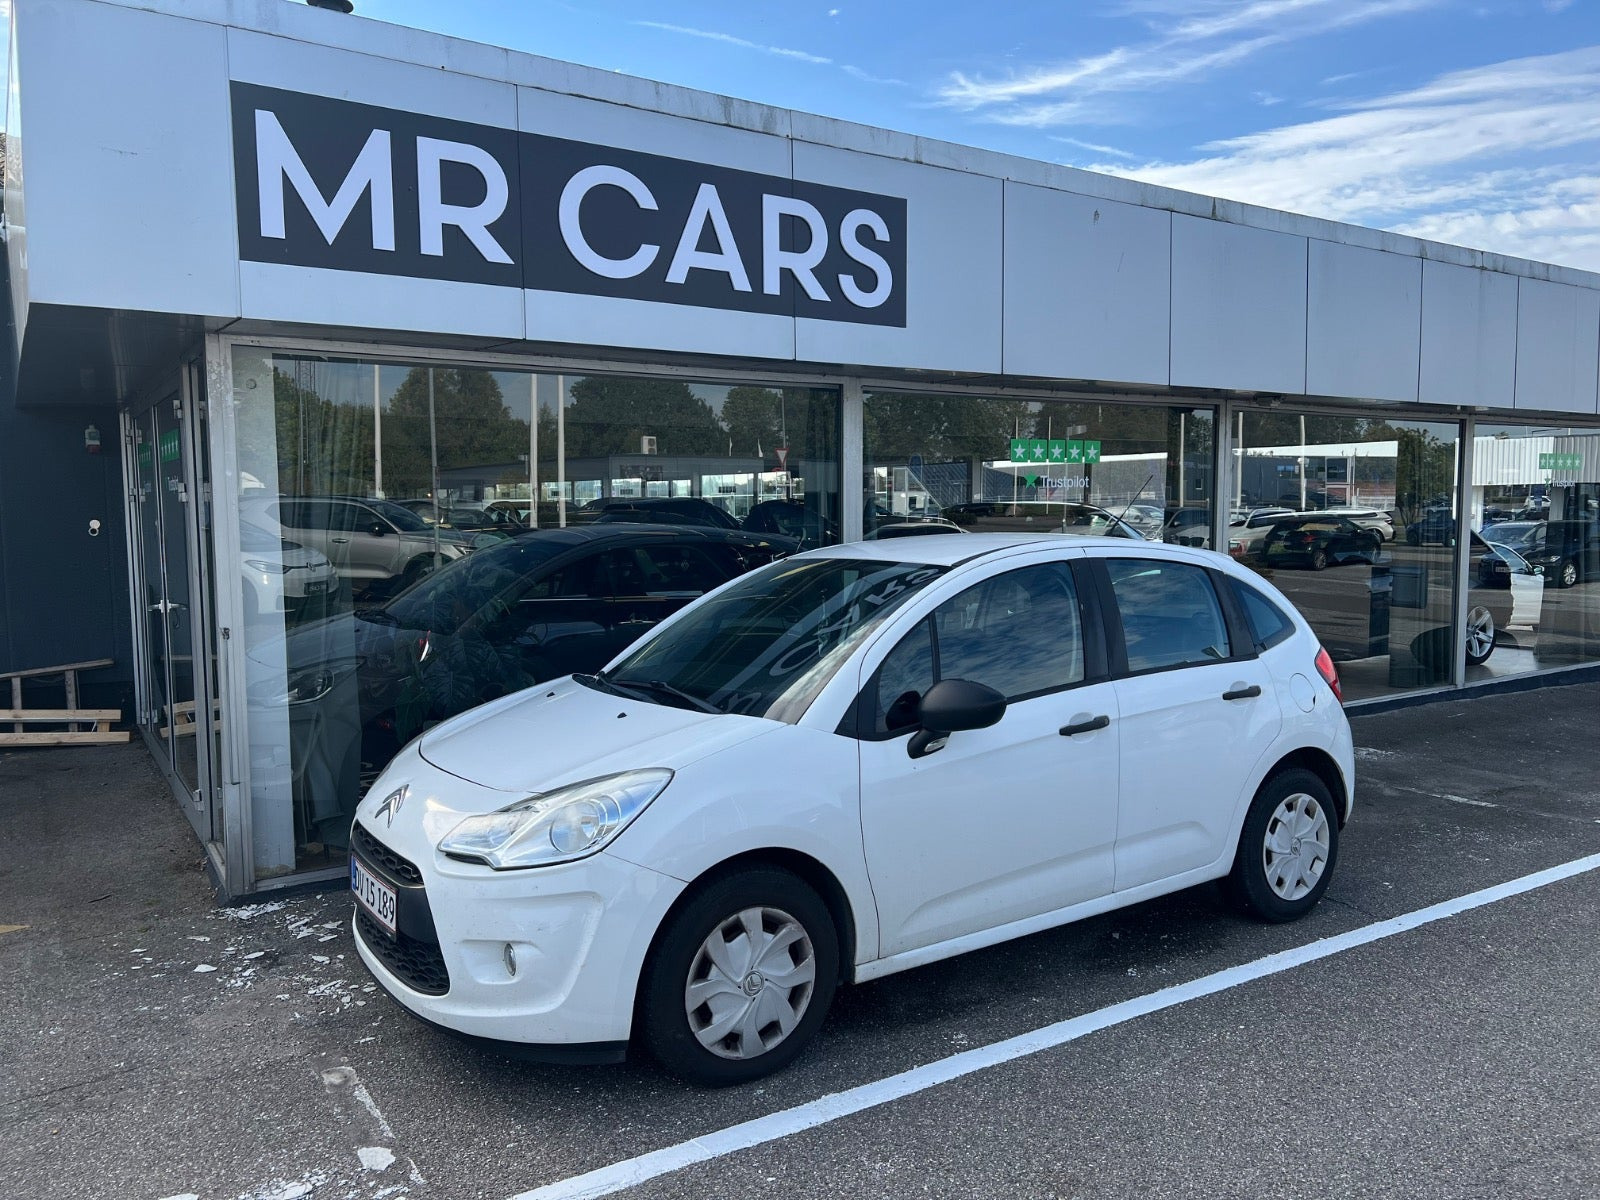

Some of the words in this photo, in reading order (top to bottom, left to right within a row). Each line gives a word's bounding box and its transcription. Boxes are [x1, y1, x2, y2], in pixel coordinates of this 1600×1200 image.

[255, 108, 514, 264] MR
[558, 164, 893, 308] CARS
[1040, 475, 1090, 490] Trustpilot
[366, 877, 375, 907] 15
[378, 887, 395, 923] 189
